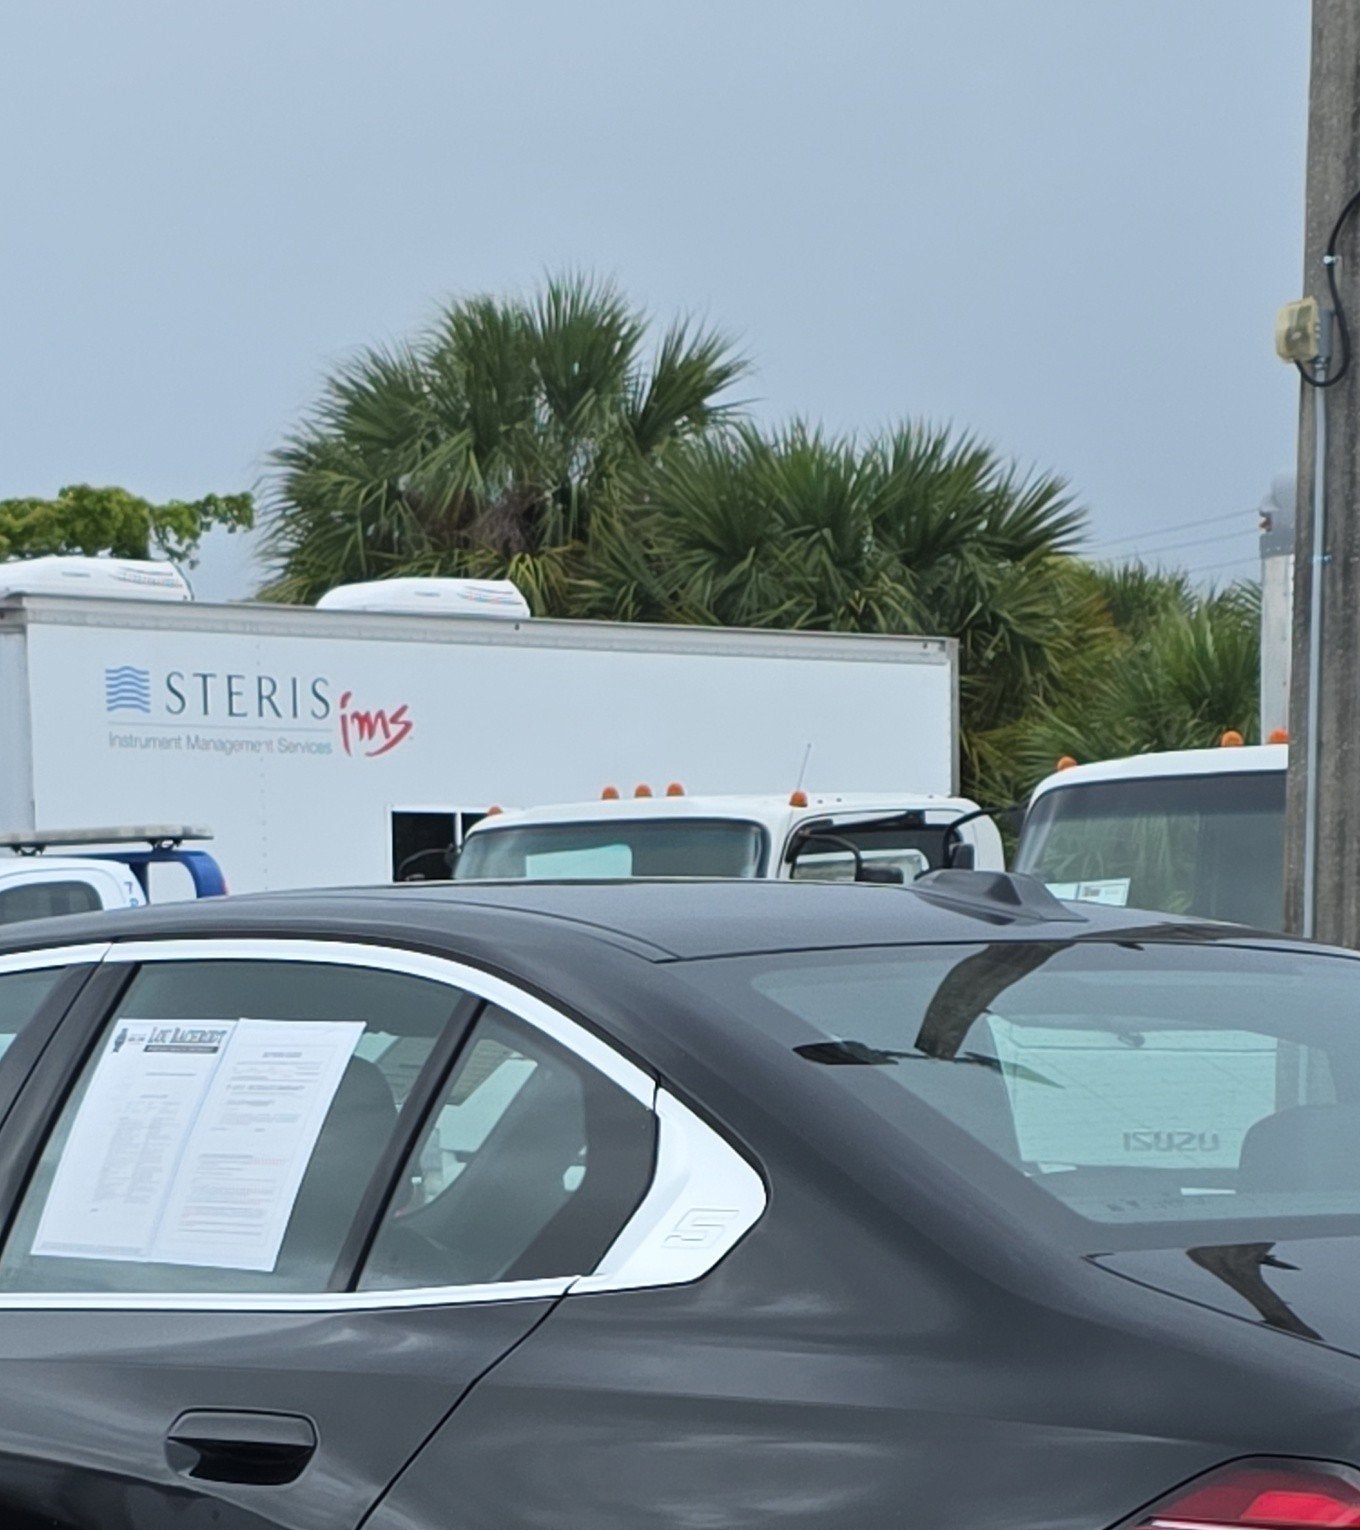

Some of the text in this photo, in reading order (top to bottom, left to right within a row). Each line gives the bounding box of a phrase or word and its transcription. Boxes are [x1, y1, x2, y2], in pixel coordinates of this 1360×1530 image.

[164, 670, 414, 758] STERIS ims
[1122, 1129, 1221, 1151] ISUZU
